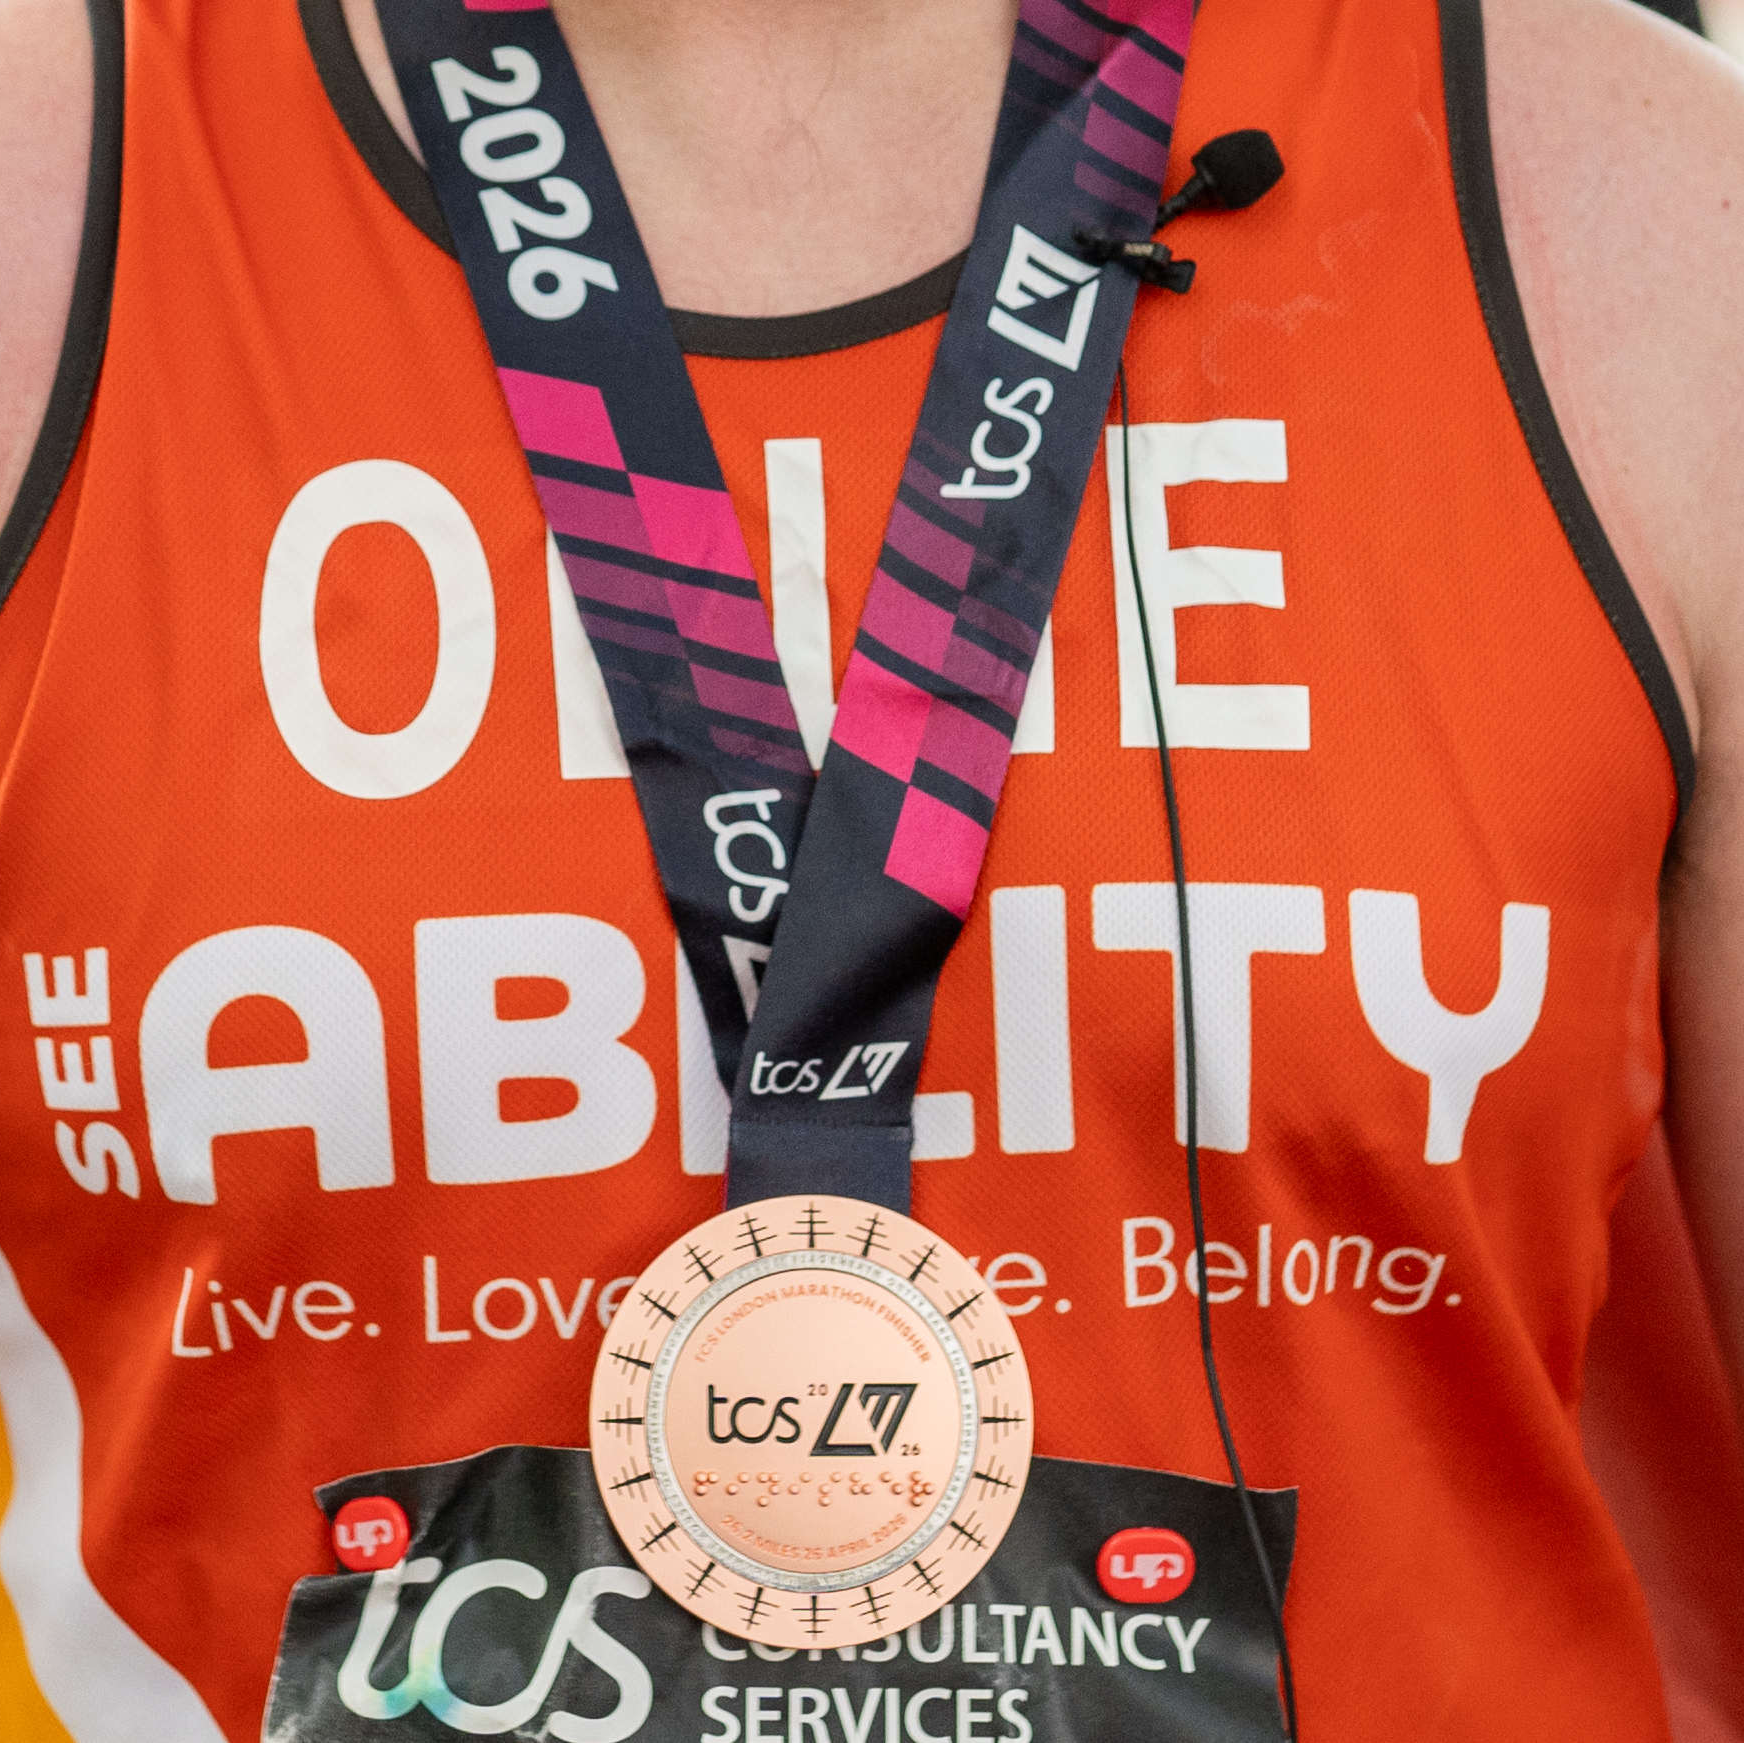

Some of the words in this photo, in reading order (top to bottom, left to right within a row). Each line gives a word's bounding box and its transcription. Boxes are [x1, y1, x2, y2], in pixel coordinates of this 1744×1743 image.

[430, 46, 619, 320] 2026
[939, 377, 1054, 499] tcs
[23, 947, 141, 1200] SEE
[138, 881, 1550, 1205] ABITY
[750, 1051, 823, 1095] tcs
[172, 1267, 380, 1357] Live.
[1122, 1217, 1461, 1316] Belong.
[695, 1334, 718, 1363] TCS
[715, 1291, 778, 1335] LONDON
[782, 1284, 876, 1310] MARATHON
[875, 1304, 931, 1363] FINISHER
[707, 1384, 801, 1444] tcs
[807, 1384, 828, 1397] 20
[755, 1537, 799, 1558] MILES
[826, 1537, 872, 1558] APRIL
[701, 1603, 1211, 1673] CSULTANCY
[700, 1685, 1034, 1743] SERVICES
